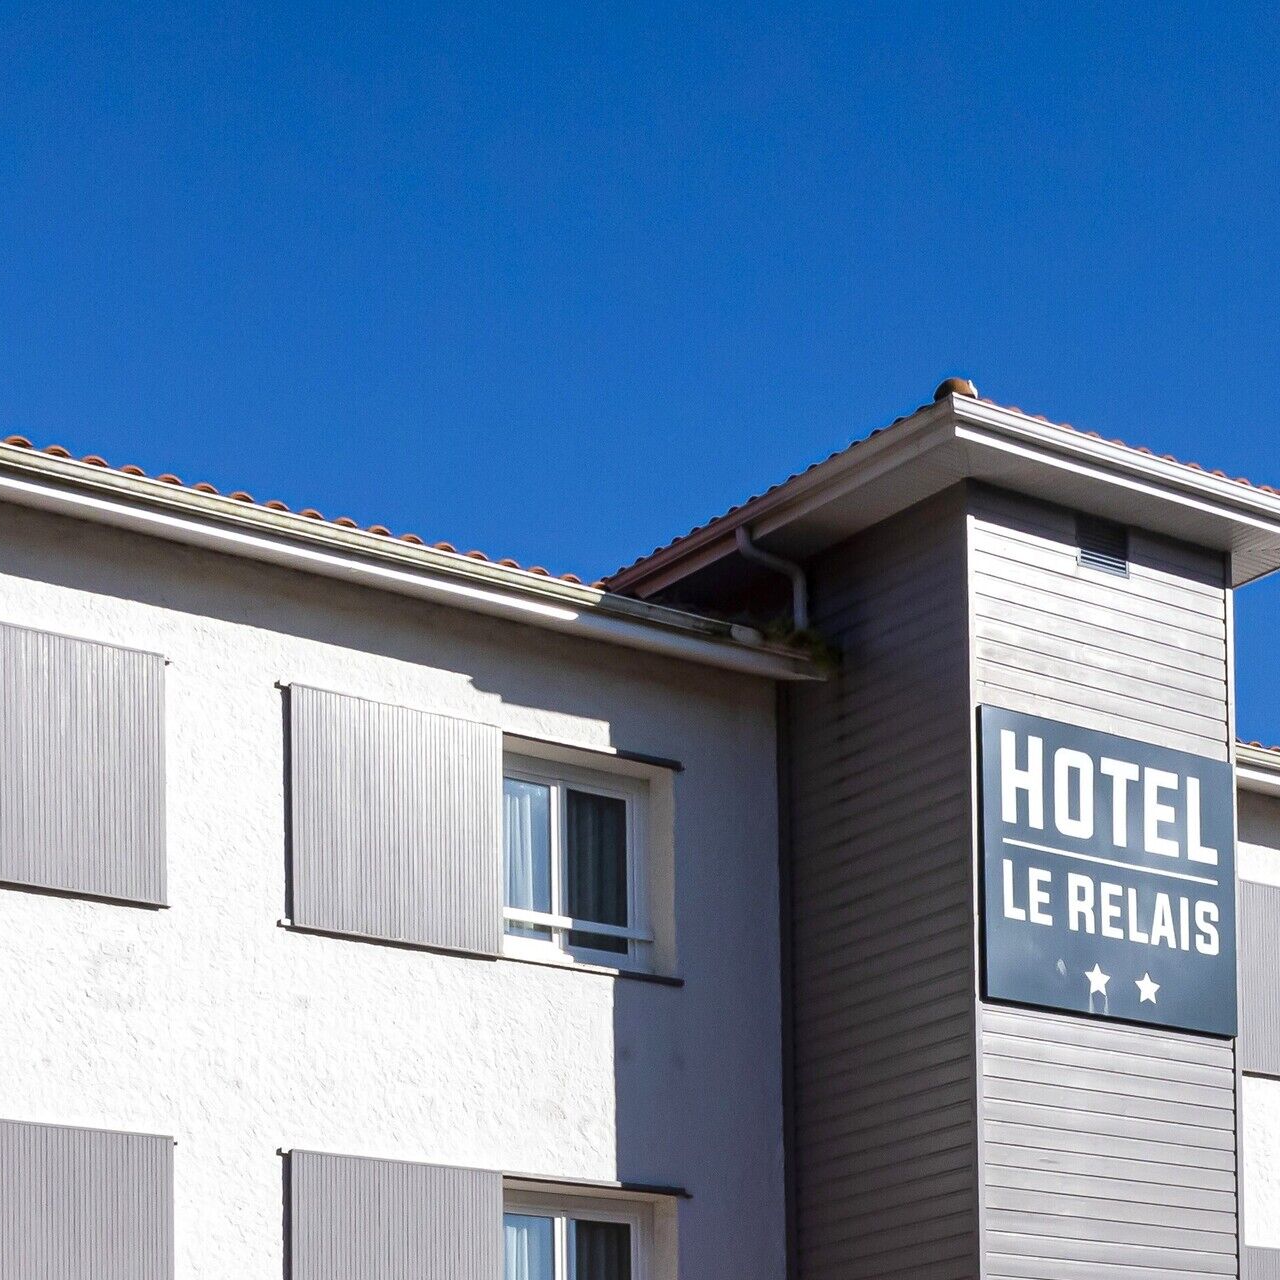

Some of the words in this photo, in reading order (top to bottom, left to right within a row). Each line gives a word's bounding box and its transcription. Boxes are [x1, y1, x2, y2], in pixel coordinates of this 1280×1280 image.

[1000, 729, 1218, 866] HOTEL
[1002, 859, 1053, 926] LE
[1067, 872, 1220, 956] RELAIS
